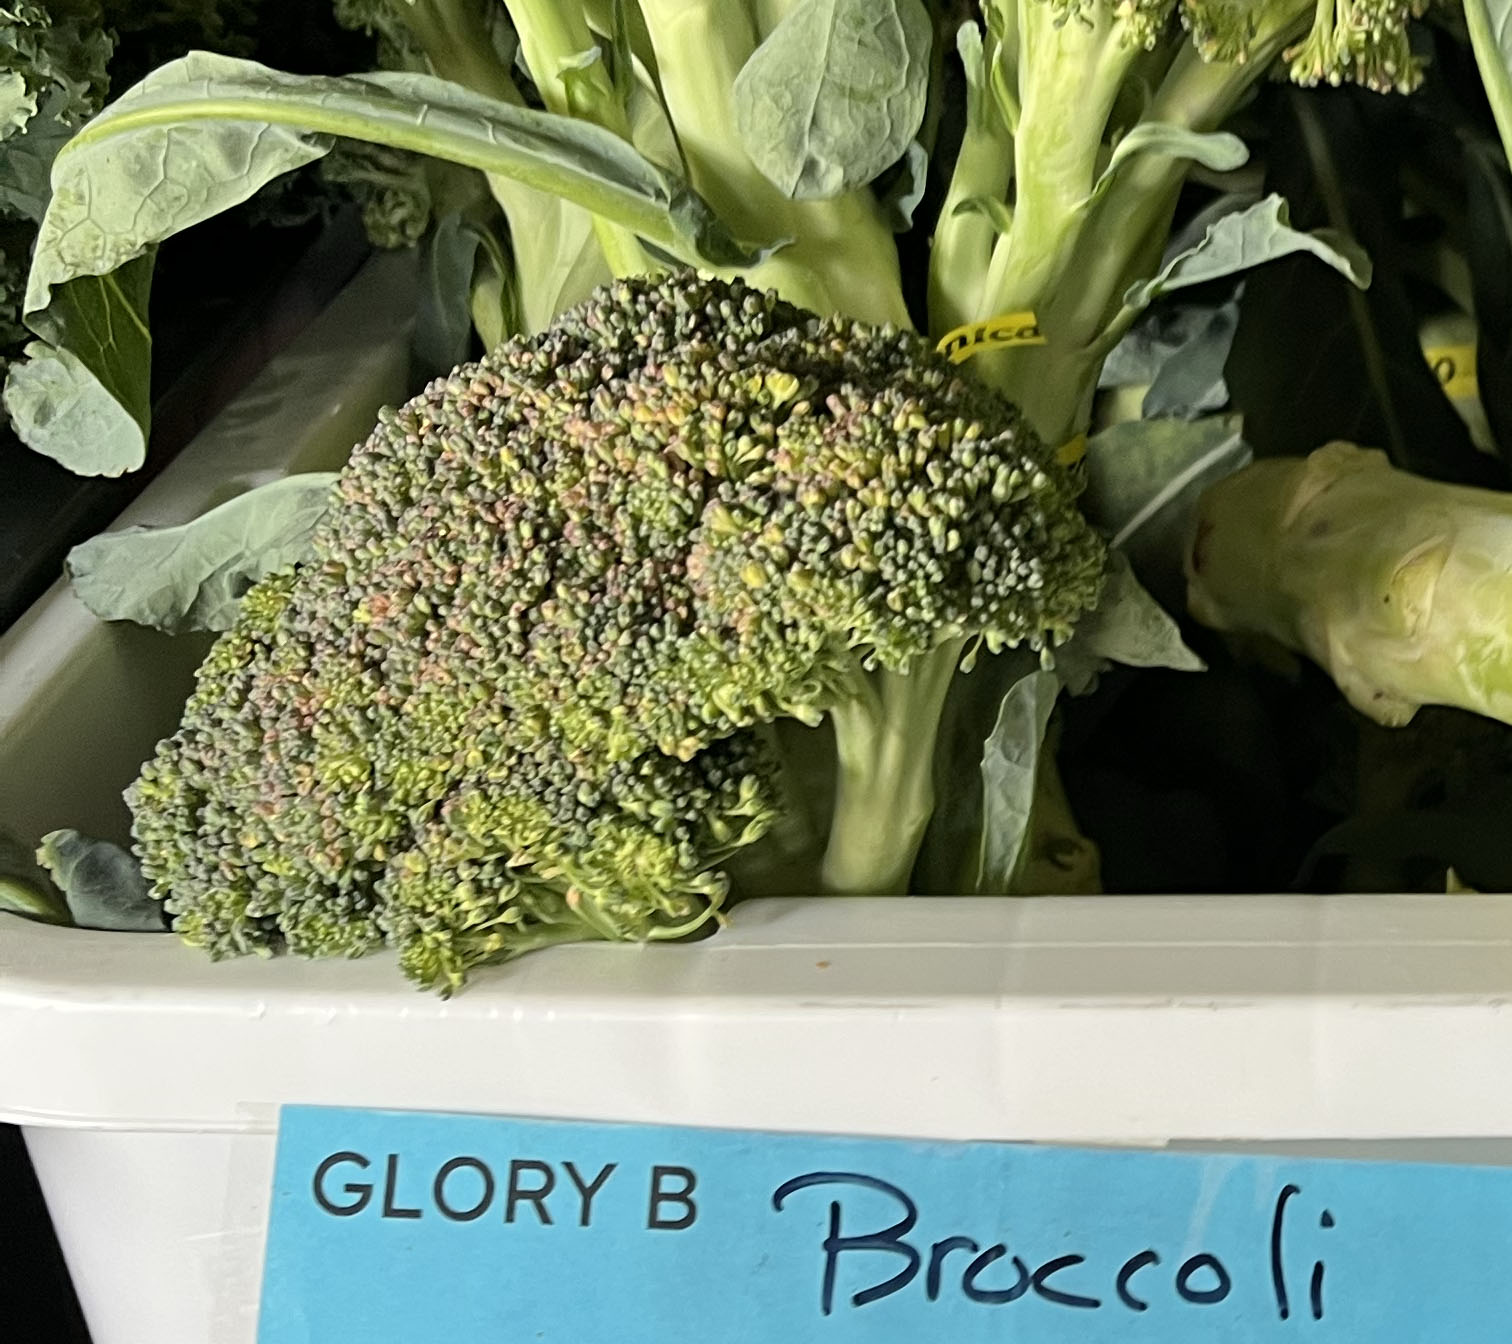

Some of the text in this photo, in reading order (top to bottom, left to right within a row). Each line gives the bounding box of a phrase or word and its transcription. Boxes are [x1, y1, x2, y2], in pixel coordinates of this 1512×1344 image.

[313, 1150, 698, 1231] GLORY B
[773, 1170, 1334, 1320] Broccoli
